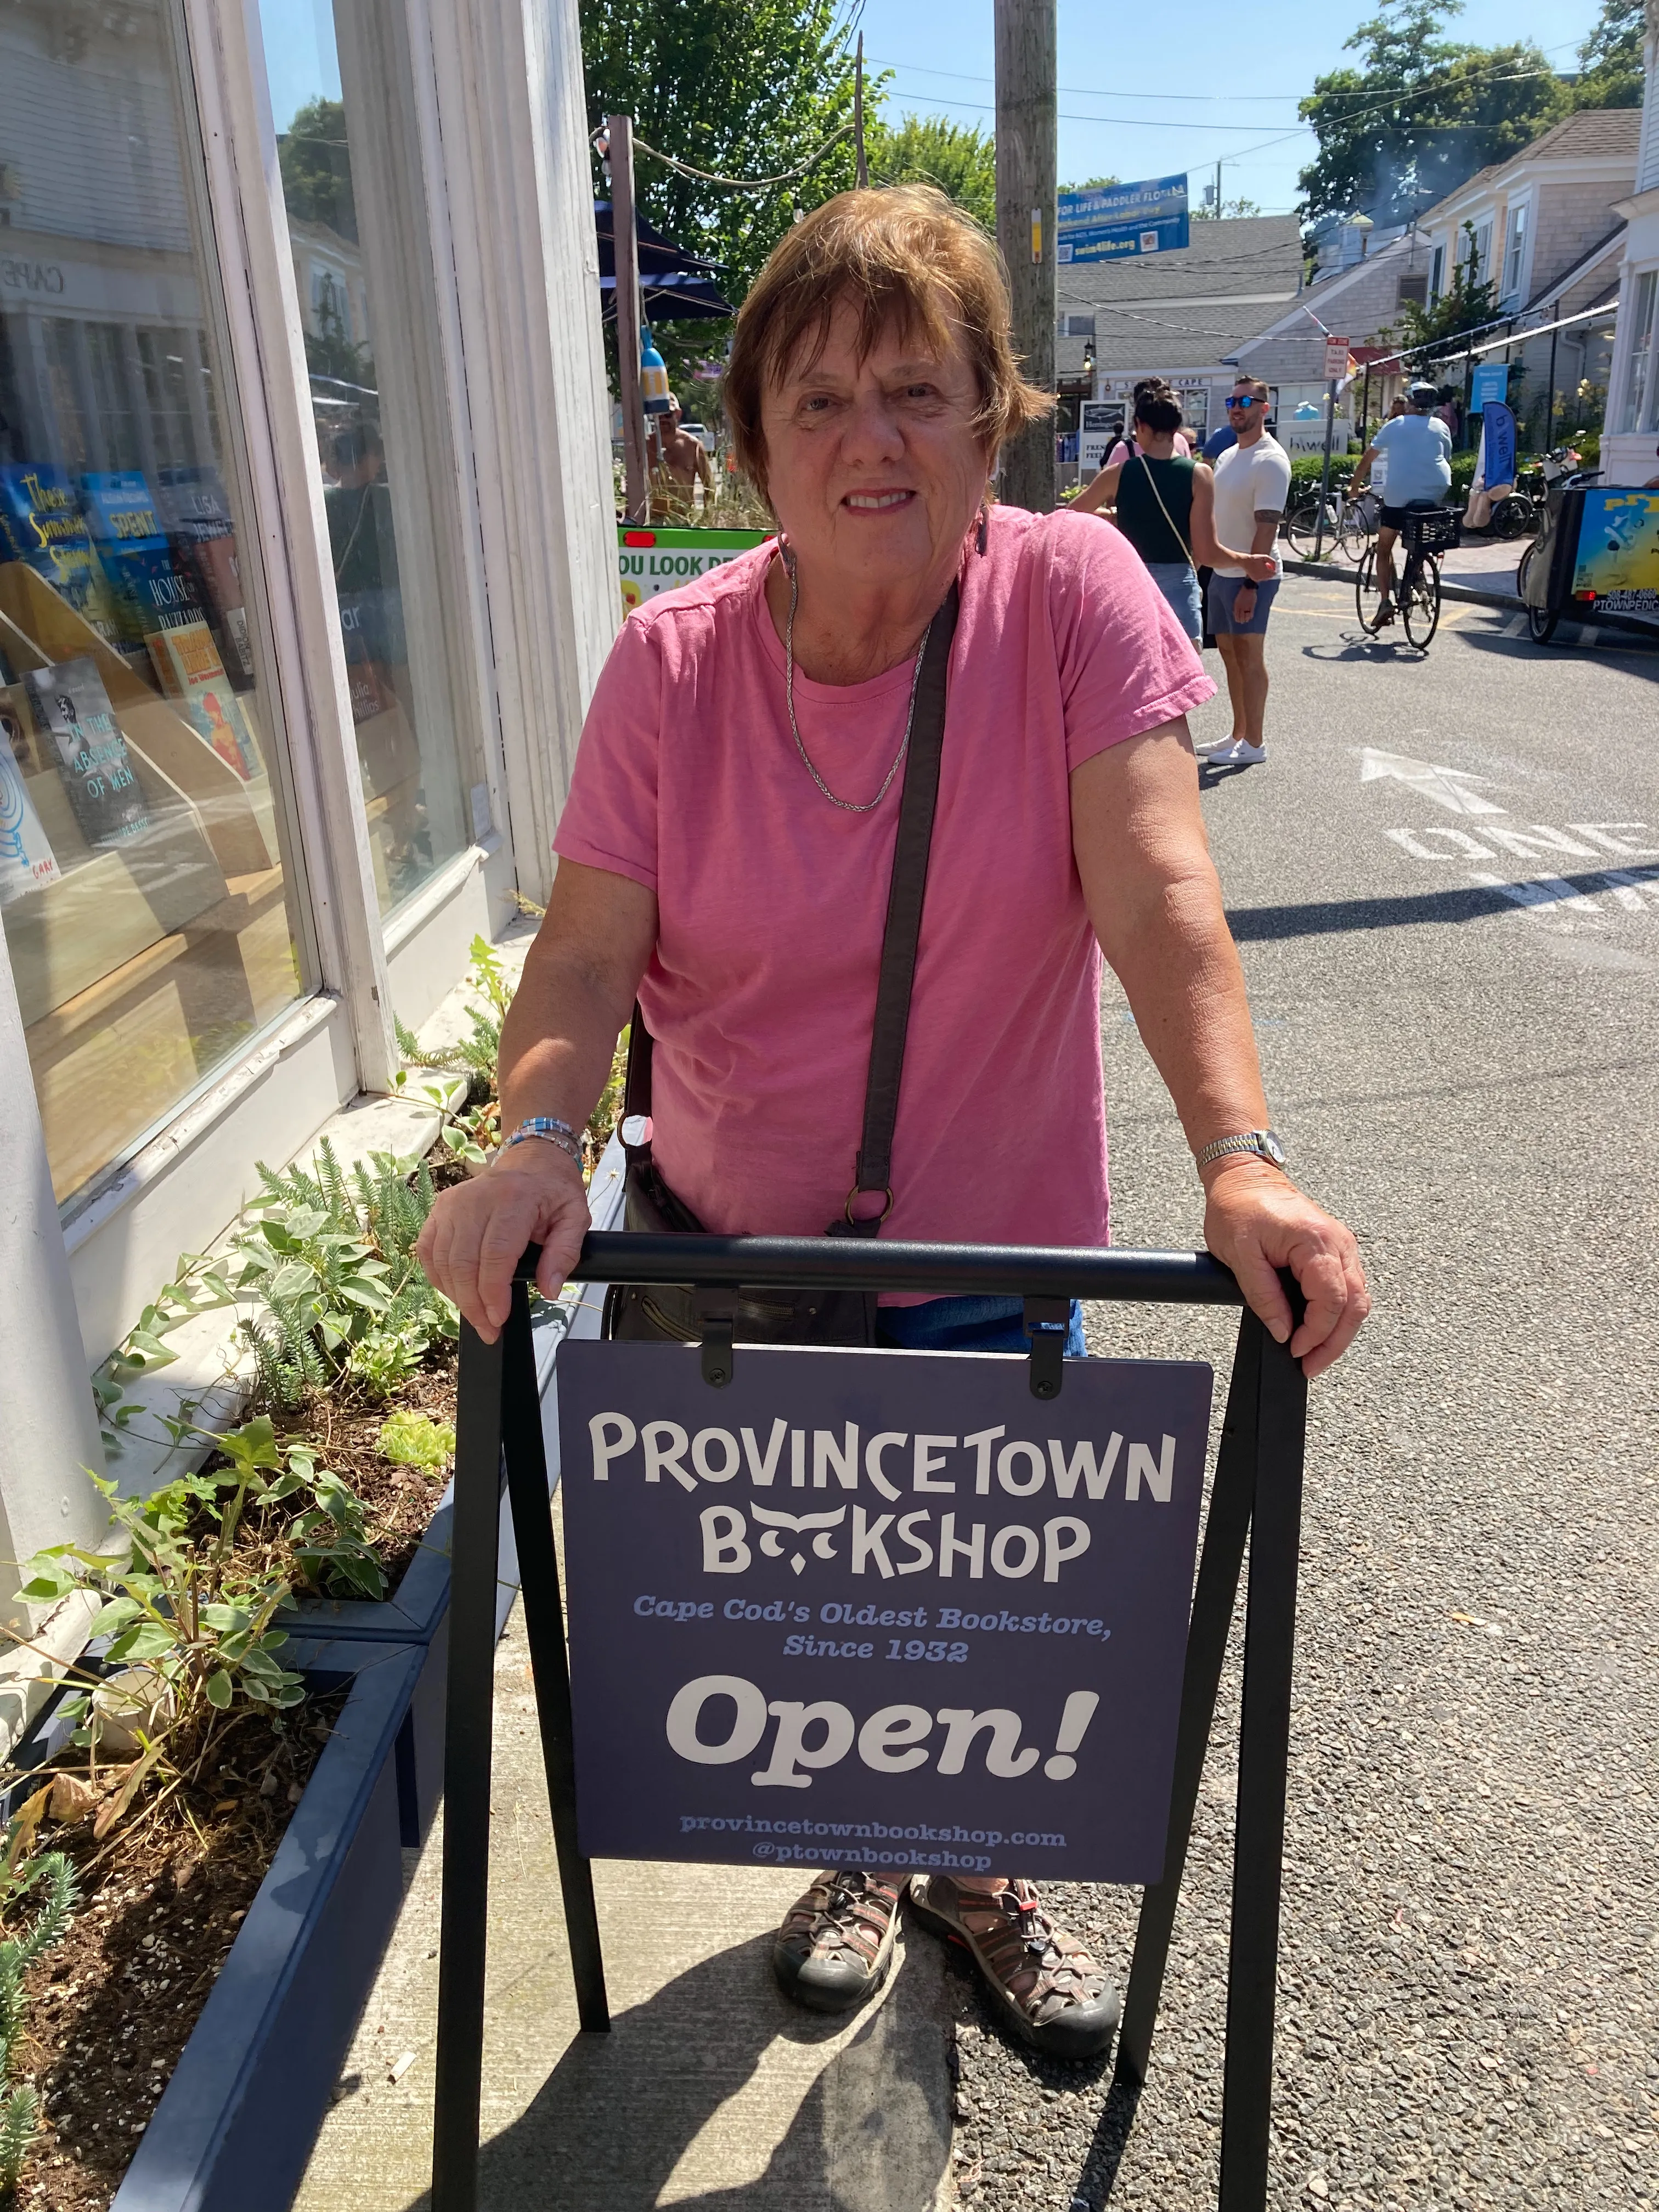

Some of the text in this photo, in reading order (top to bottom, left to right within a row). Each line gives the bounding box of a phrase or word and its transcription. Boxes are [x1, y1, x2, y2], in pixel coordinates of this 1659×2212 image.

[1076, 202, 1092, 213] LIFE
[1101, 194, 1141, 208] PADDLER
[1075, 240, 1136, 256] swim4life.org
[191, 494, 222, 516] LISA
[109, 510, 160, 539] SPENT
[650, 556, 704, 576] LOOK
[148, 574, 190, 607] HOUSE
[1593, 599, 1659, 611] PTOWNPEDIC
[86, 713, 112, 736] THE
[73, 737, 128, 774] ABSENCE
[87, 766, 136, 799] OF MEN
[32, 857, 53, 880] GARY
[588, 1412, 1176, 1503] PROVINCETOWN
[634, 1595, 1111, 1641] Cape Cod's Oldest Bookstore,
[783, 1635, 969, 1663] Since 1932
[666, 1675, 1100, 1788] Open!
[680, 1815, 1067, 1847] provincetownbookshop.com
[753, 1842, 991, 1872] @ptownbookshop
